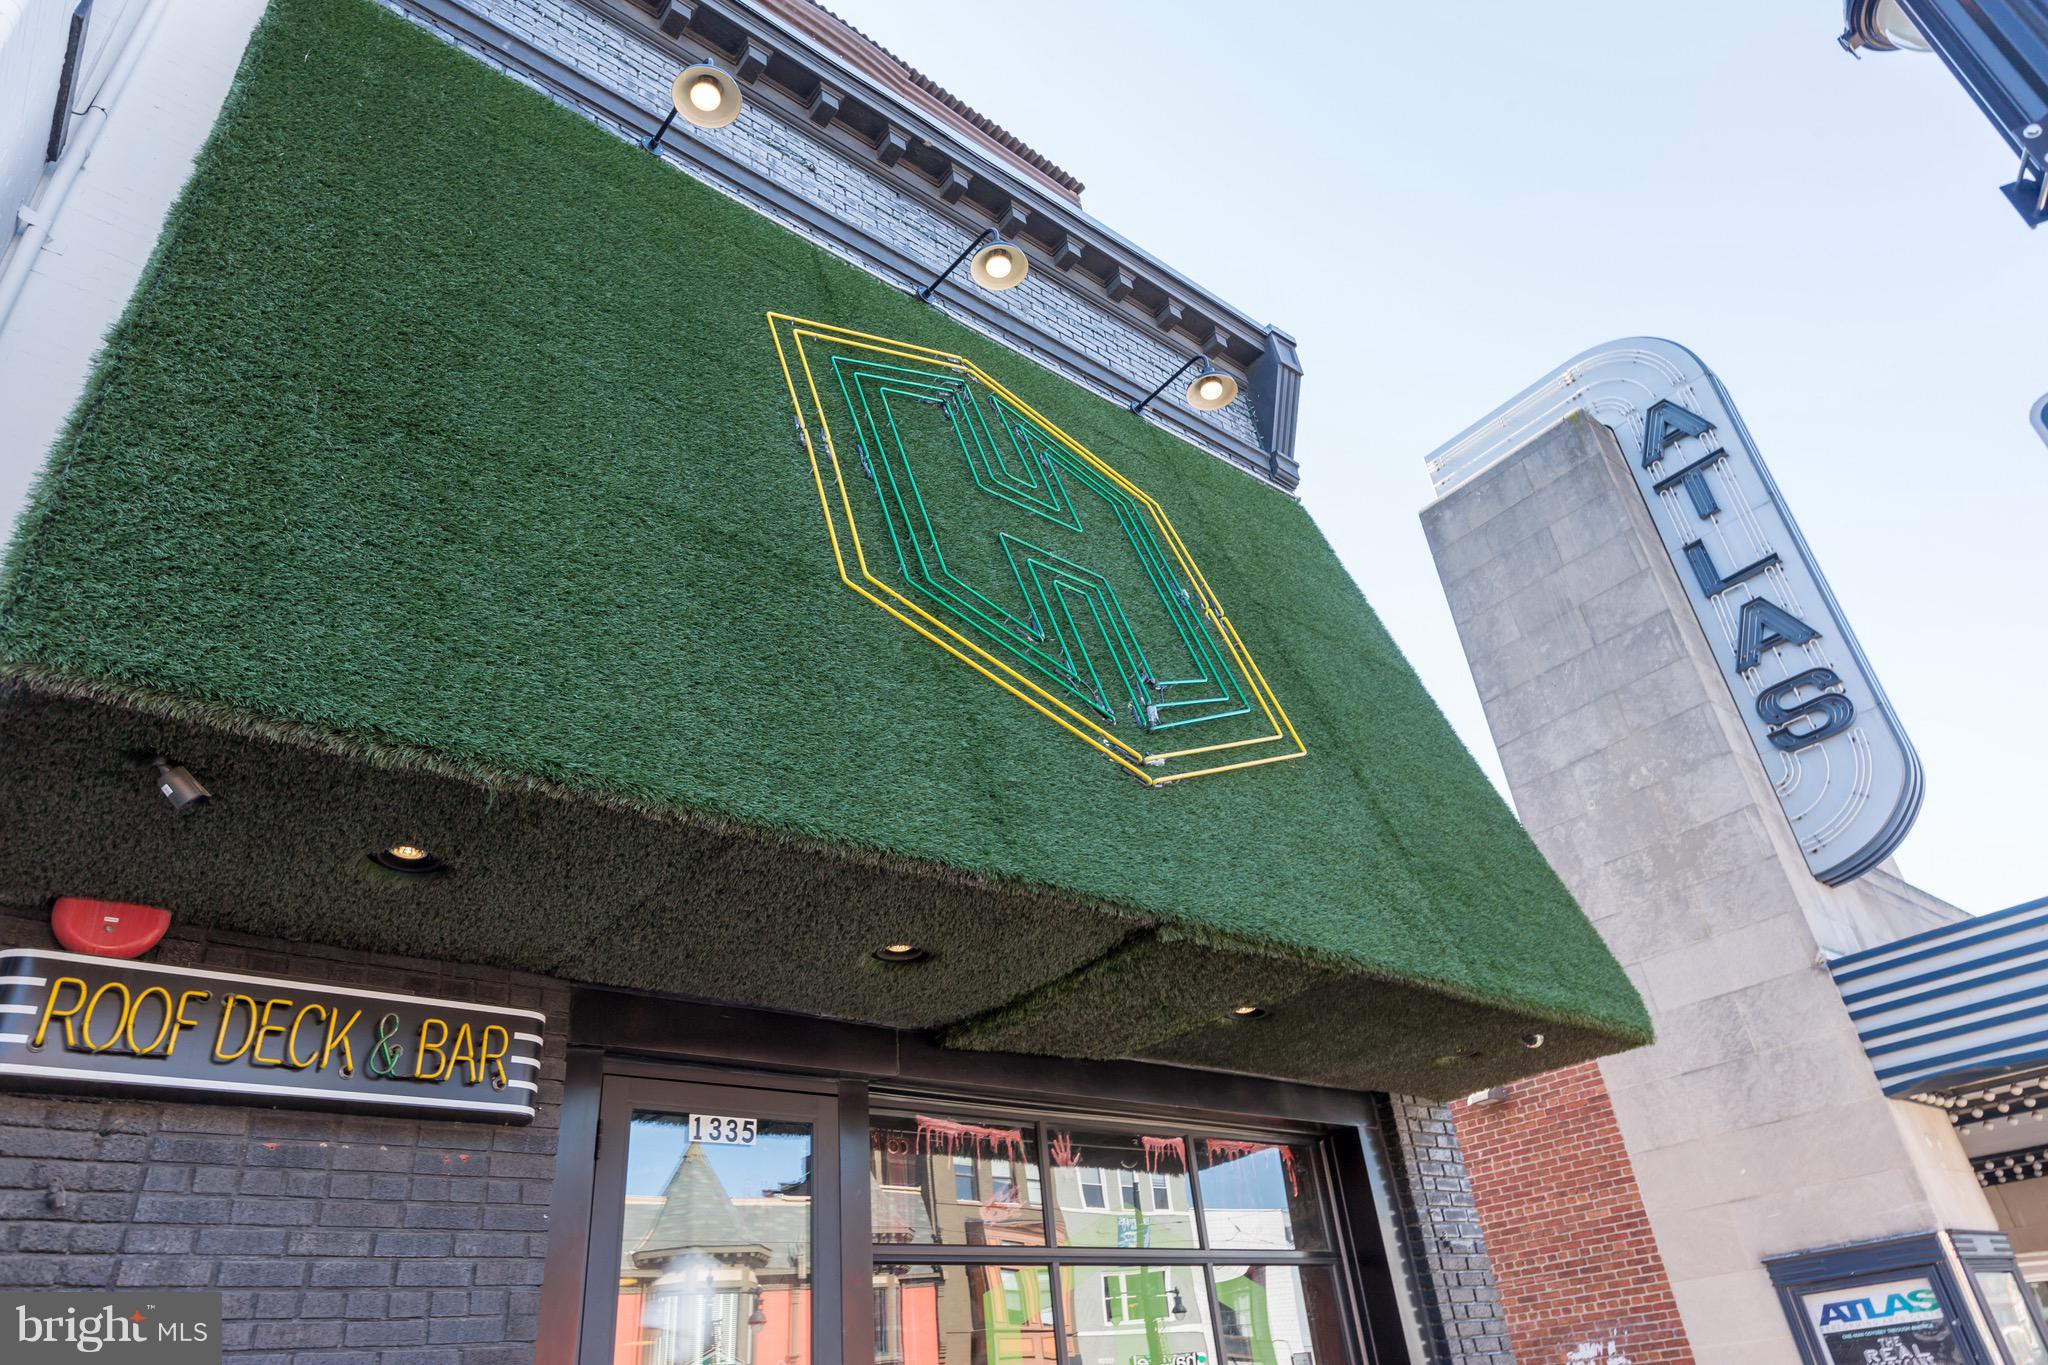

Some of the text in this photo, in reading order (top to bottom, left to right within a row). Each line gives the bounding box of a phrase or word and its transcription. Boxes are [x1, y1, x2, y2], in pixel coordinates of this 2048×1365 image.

[1641, 398, 1857, 752] ATLAS
[34, 976, 510, 1088] ROOF DECK & BAR
[693, 1116, 754, 1143] 1335
[1820, 1288, 1941, 1326] ATLAS
[1863, 1343, 1930, 1363] REAL
[1877, 1335, 1903, 1349] THE
